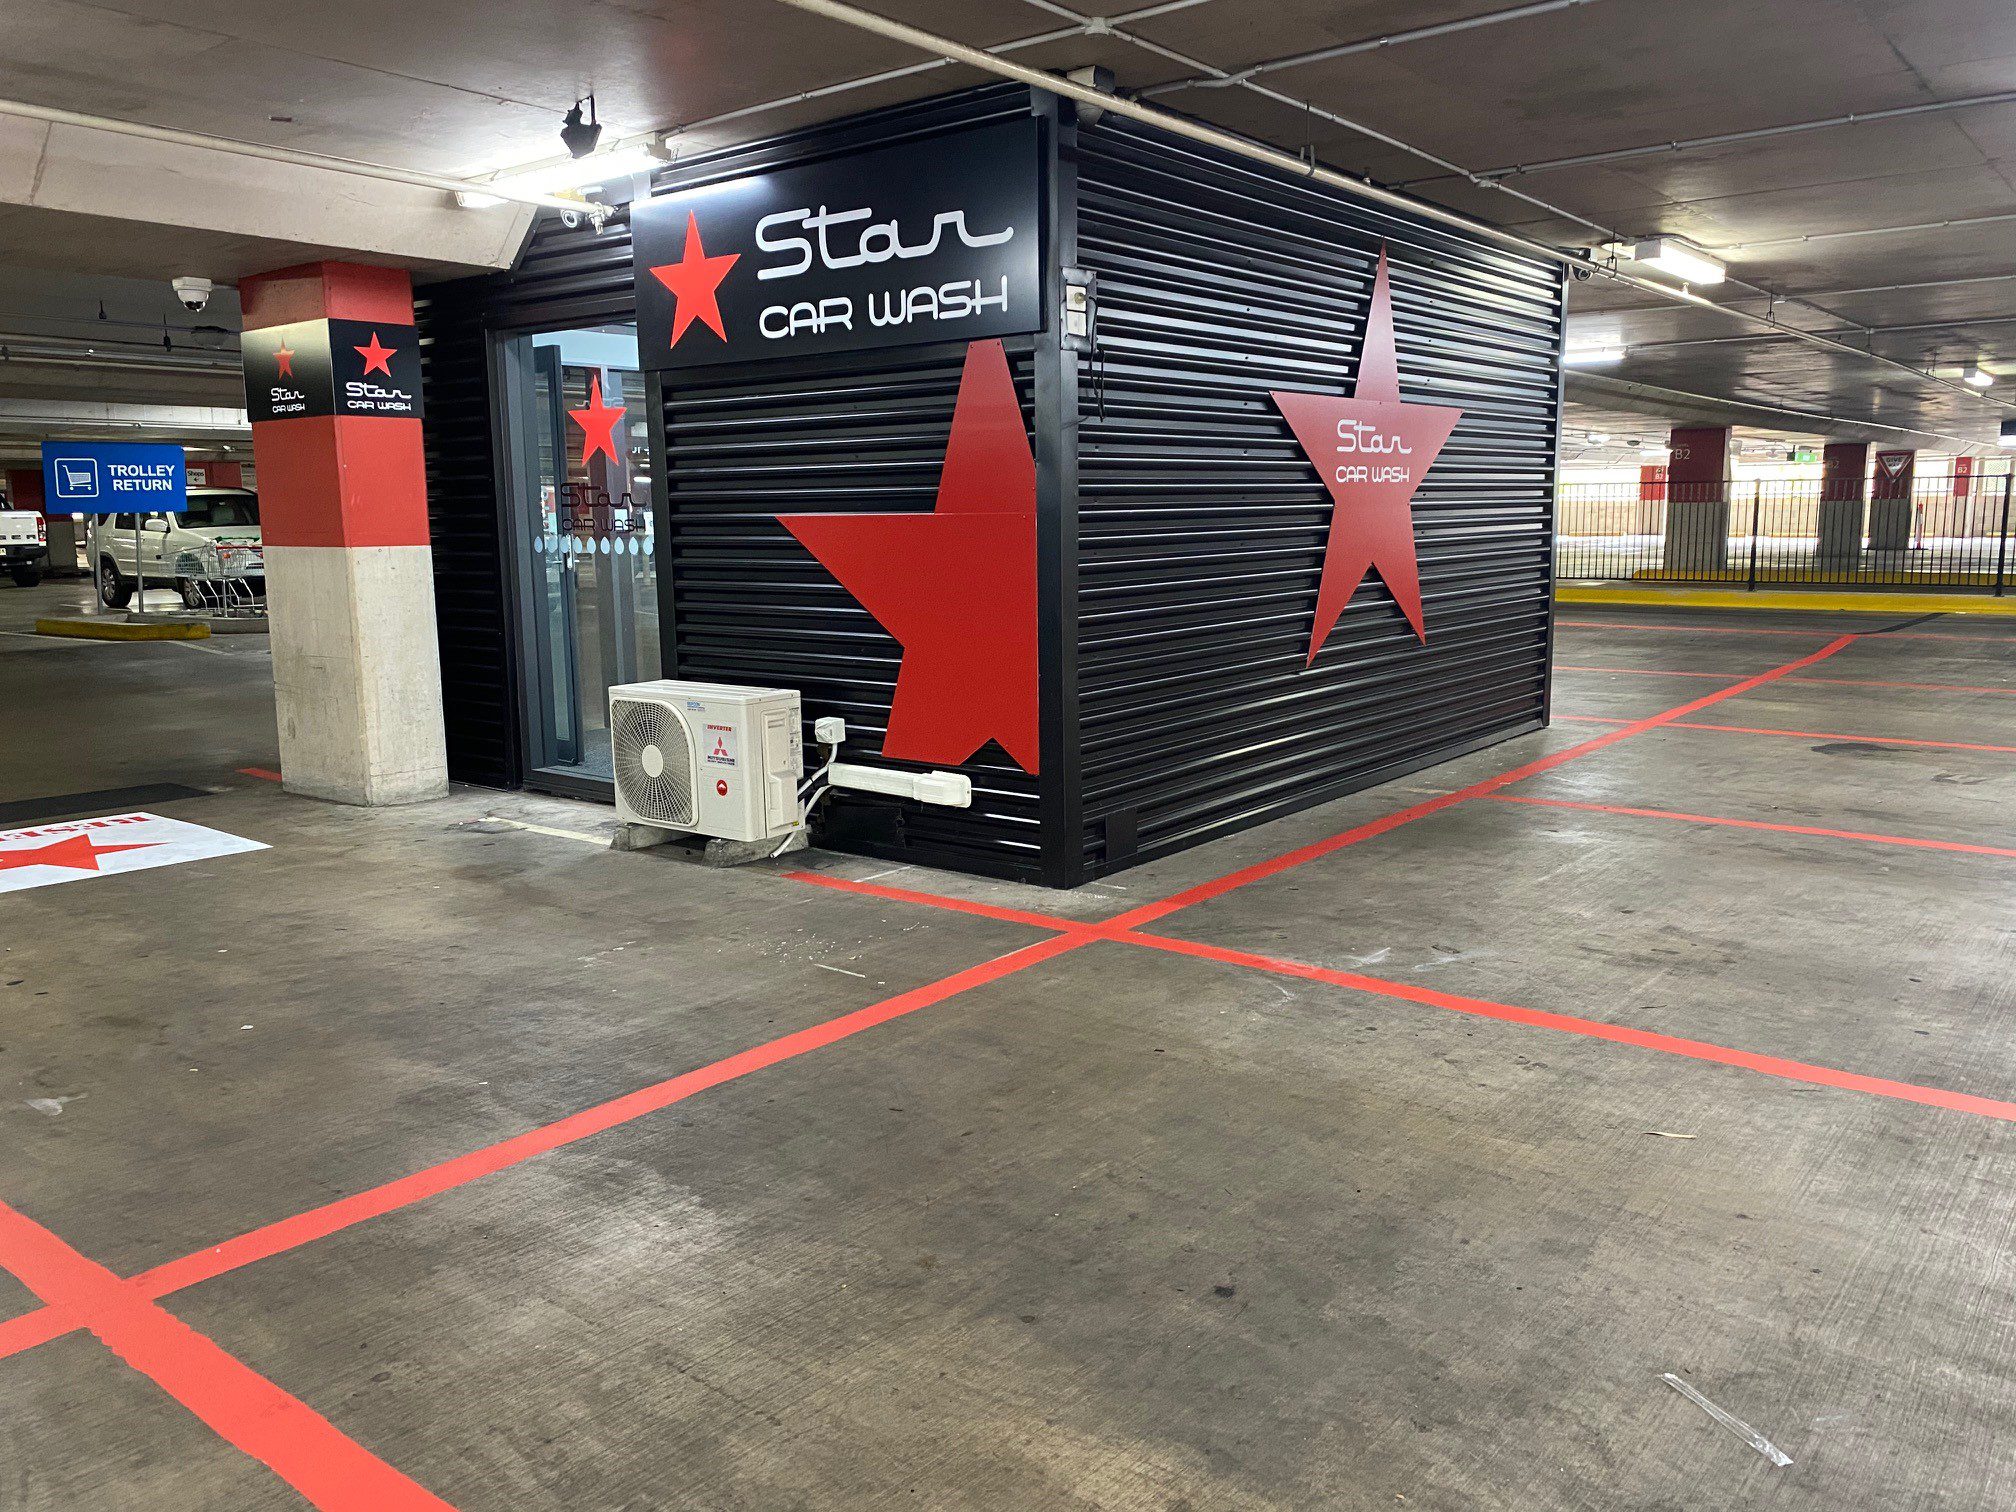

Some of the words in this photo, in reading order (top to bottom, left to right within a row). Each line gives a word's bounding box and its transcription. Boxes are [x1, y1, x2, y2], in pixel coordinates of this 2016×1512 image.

[755, 205, 1014, 280] Star
[759, 296, 853, 339] CAR
[868, 274, 1008, 327] WASH
[270, 387, 305, 402] Star
[346, 381, 412, 399] Star
[272, 404, 286, 414] CAR
[286, 403, 306, 412] WASH
[346, 400, 375, 410] CAR
[377, 401, 412, 411] WASH
[1336, 419, 1413, 455] Star
[1675, 448, 1690, 460] B2
[107, 464, 175, 478] TROLLEY
[1335, 466, 1368, 484] CAR
[1371, 466, 1410, 483] WASH
[112, 479, 173, 491] RETURN
[560, 482, 648, 508] Star
[562, 518, 596, 532] CAR
[599, 518, 646, 532] WASH
